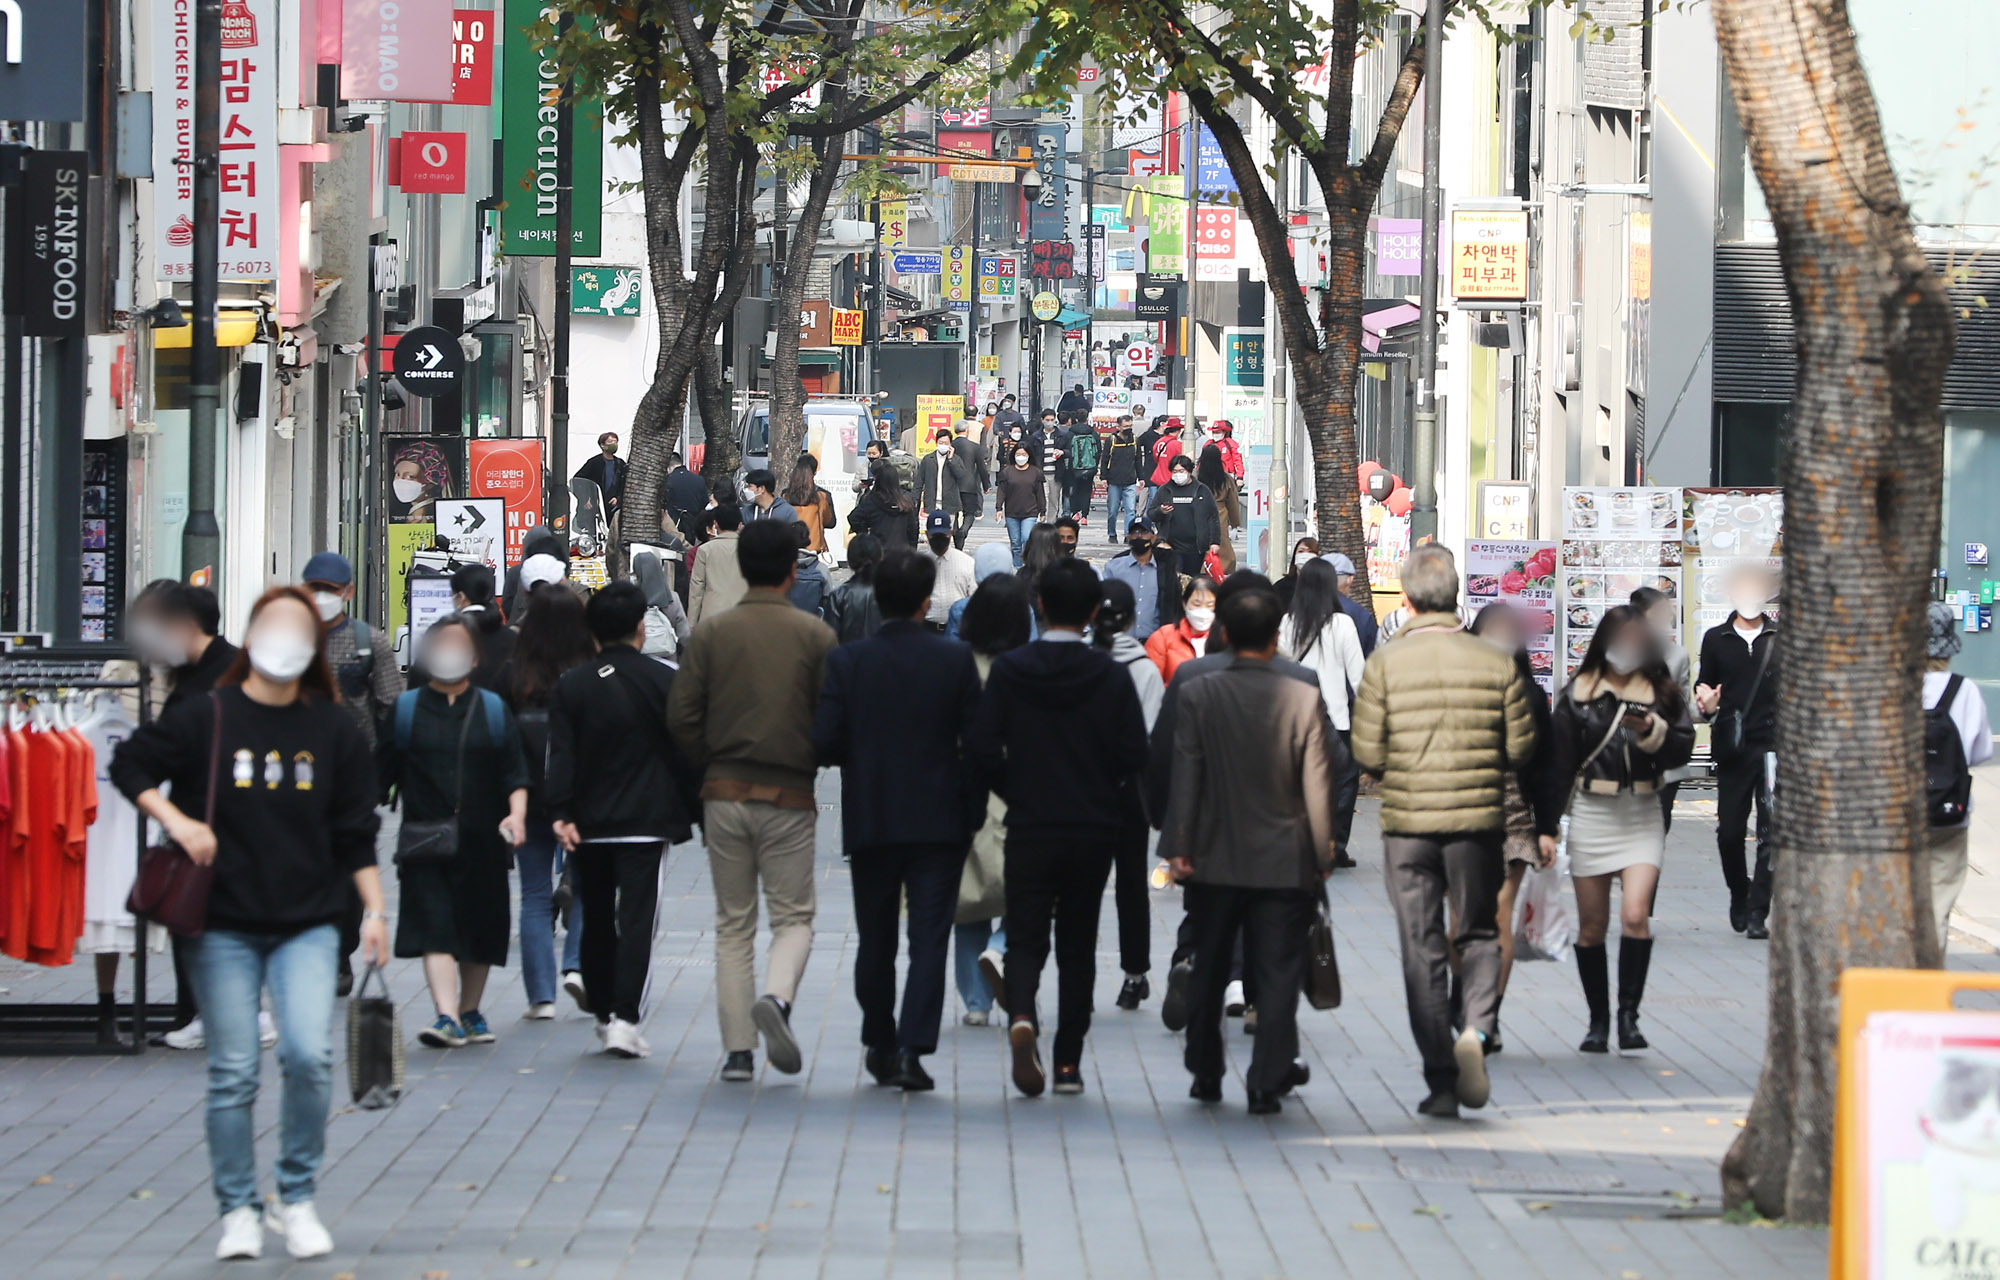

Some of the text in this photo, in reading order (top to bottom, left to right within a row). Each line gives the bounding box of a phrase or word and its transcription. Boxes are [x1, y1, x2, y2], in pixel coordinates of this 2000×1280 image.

[1079, 69, 1095, 80] 5G
[175, 0, 191, 200] CHICKEN & BURGER
[962, 108, 988, 126] 2F
[219, 58, 257, 249] 맘스터치
[414, 172, 455, 181] red mango
[1205, 170, 1219, 181] 7F
[1478, 228, 1502, 238] CNP
[34, 225, 48, 260] 1957
[53, 167, 79, 320] SKINFOOD
[1382, 234, 1422, 248] HOLIK
[1382, 247, 1422, 260] HOLIK
[1462, 244, 1518, 264] 차앤박
[217, 260, 272, 275] 7-6073
[1462, 266, 1517, 283] 피부과
[1033, 299, 1058, 310] 부동산
[834, 312, 861, 328] ABC
[833, 327, 861, 338] MART
[1127, 346, 1154, 372] 약
[404, 370, 454, 379] CONVERSE
[1492, 494, 1522, 506] CNP
